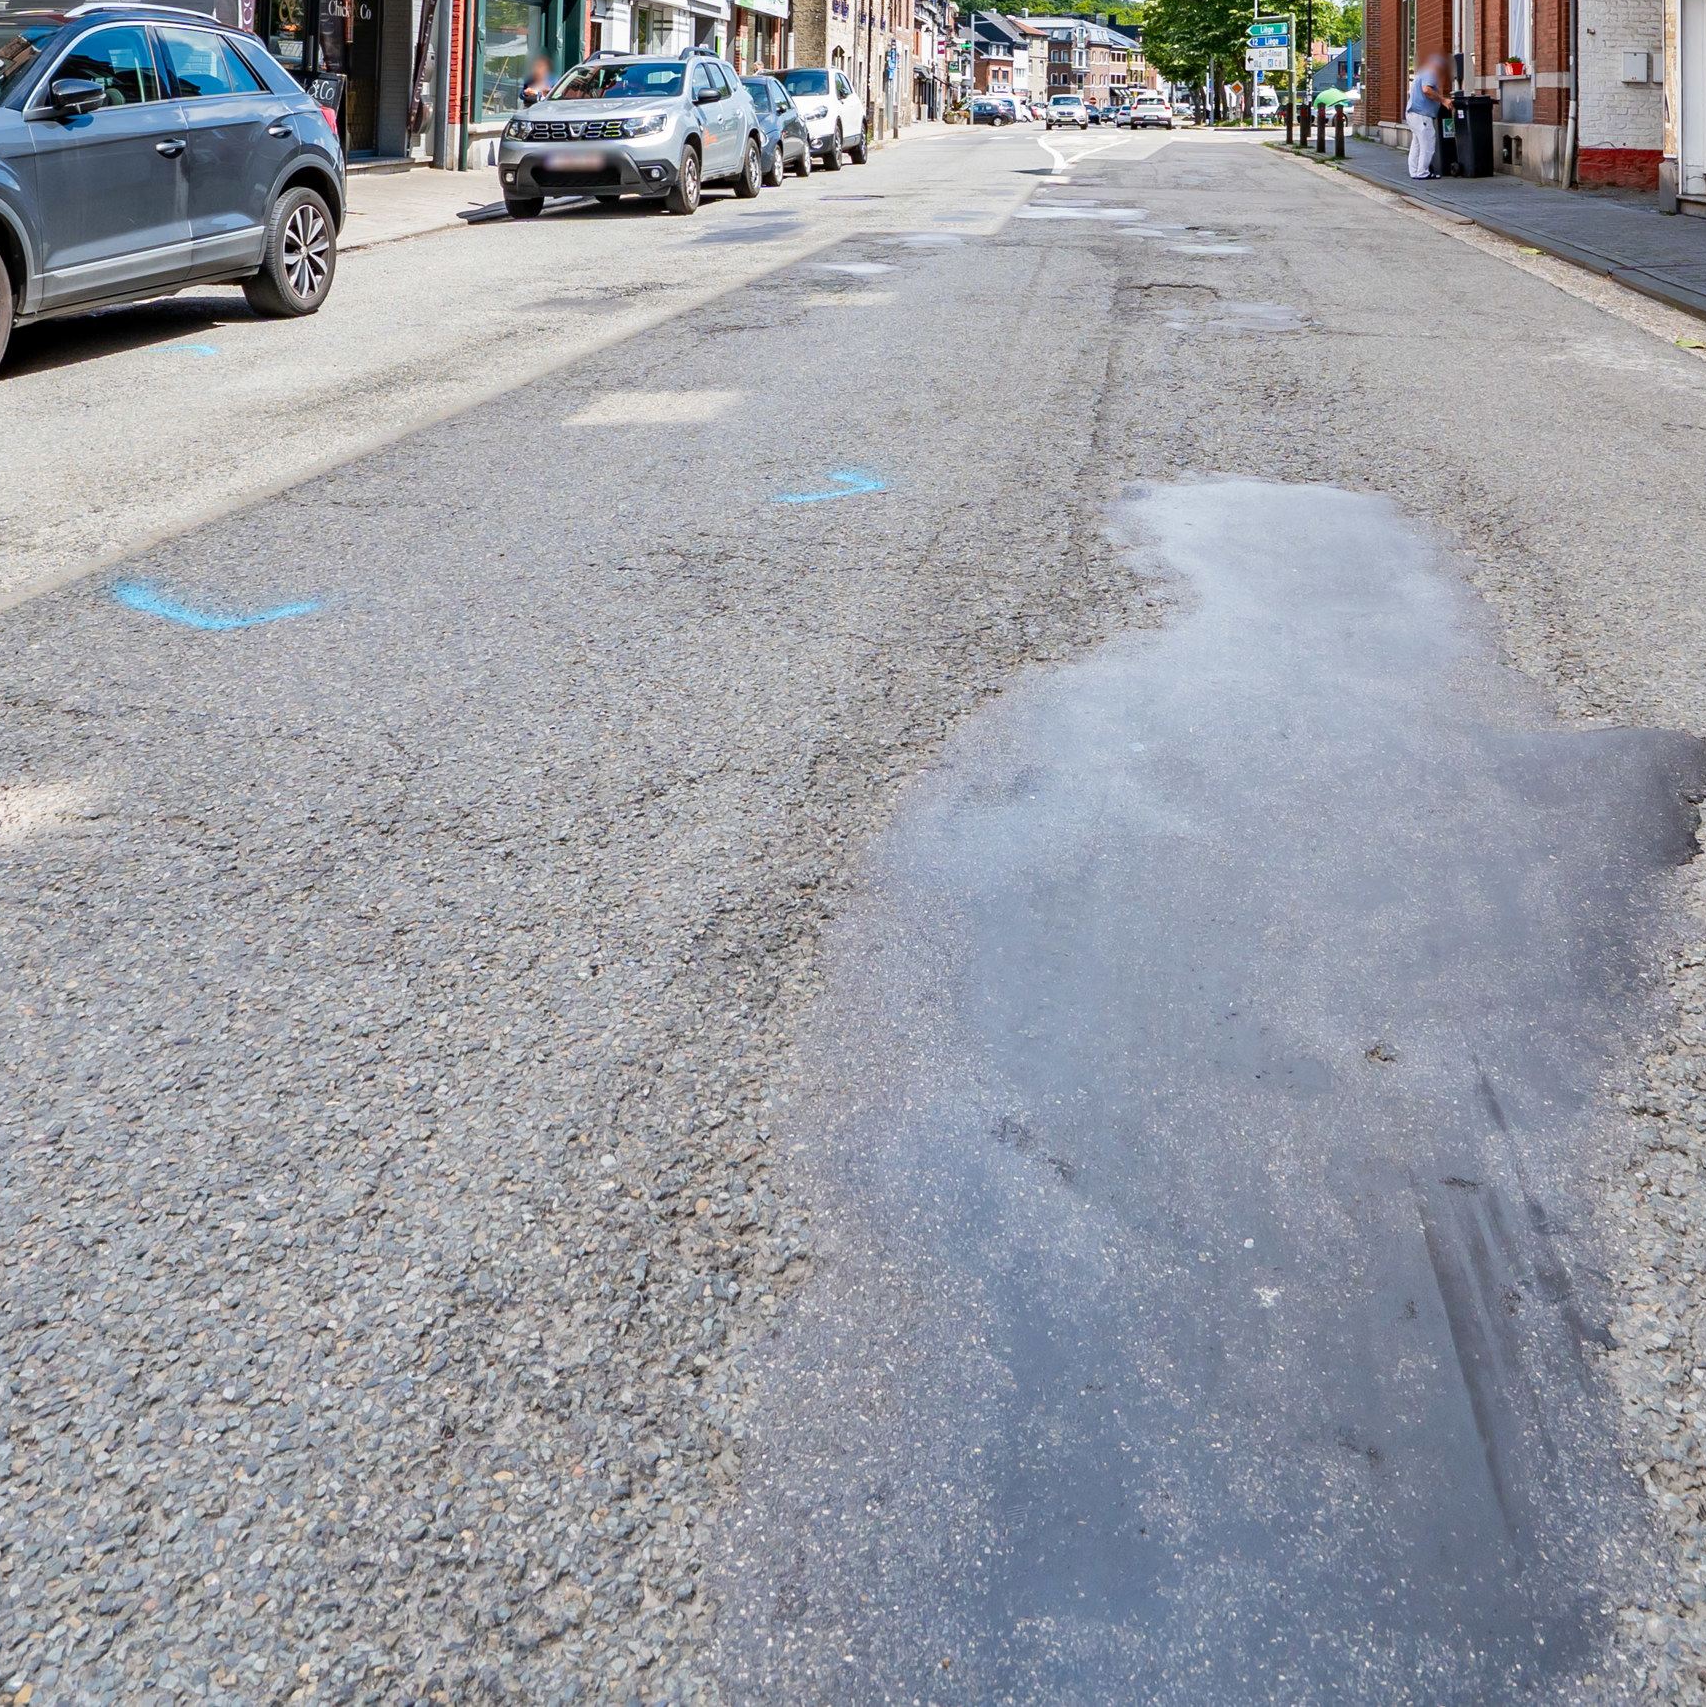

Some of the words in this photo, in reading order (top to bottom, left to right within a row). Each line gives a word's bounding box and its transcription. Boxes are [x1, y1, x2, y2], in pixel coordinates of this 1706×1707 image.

[328, 0, 351, 18] Chick
[360, 3, 372, 20] Co
[1260, 25, 1274, 34] Liège
[1265, 37, 1279, 46] Liège
